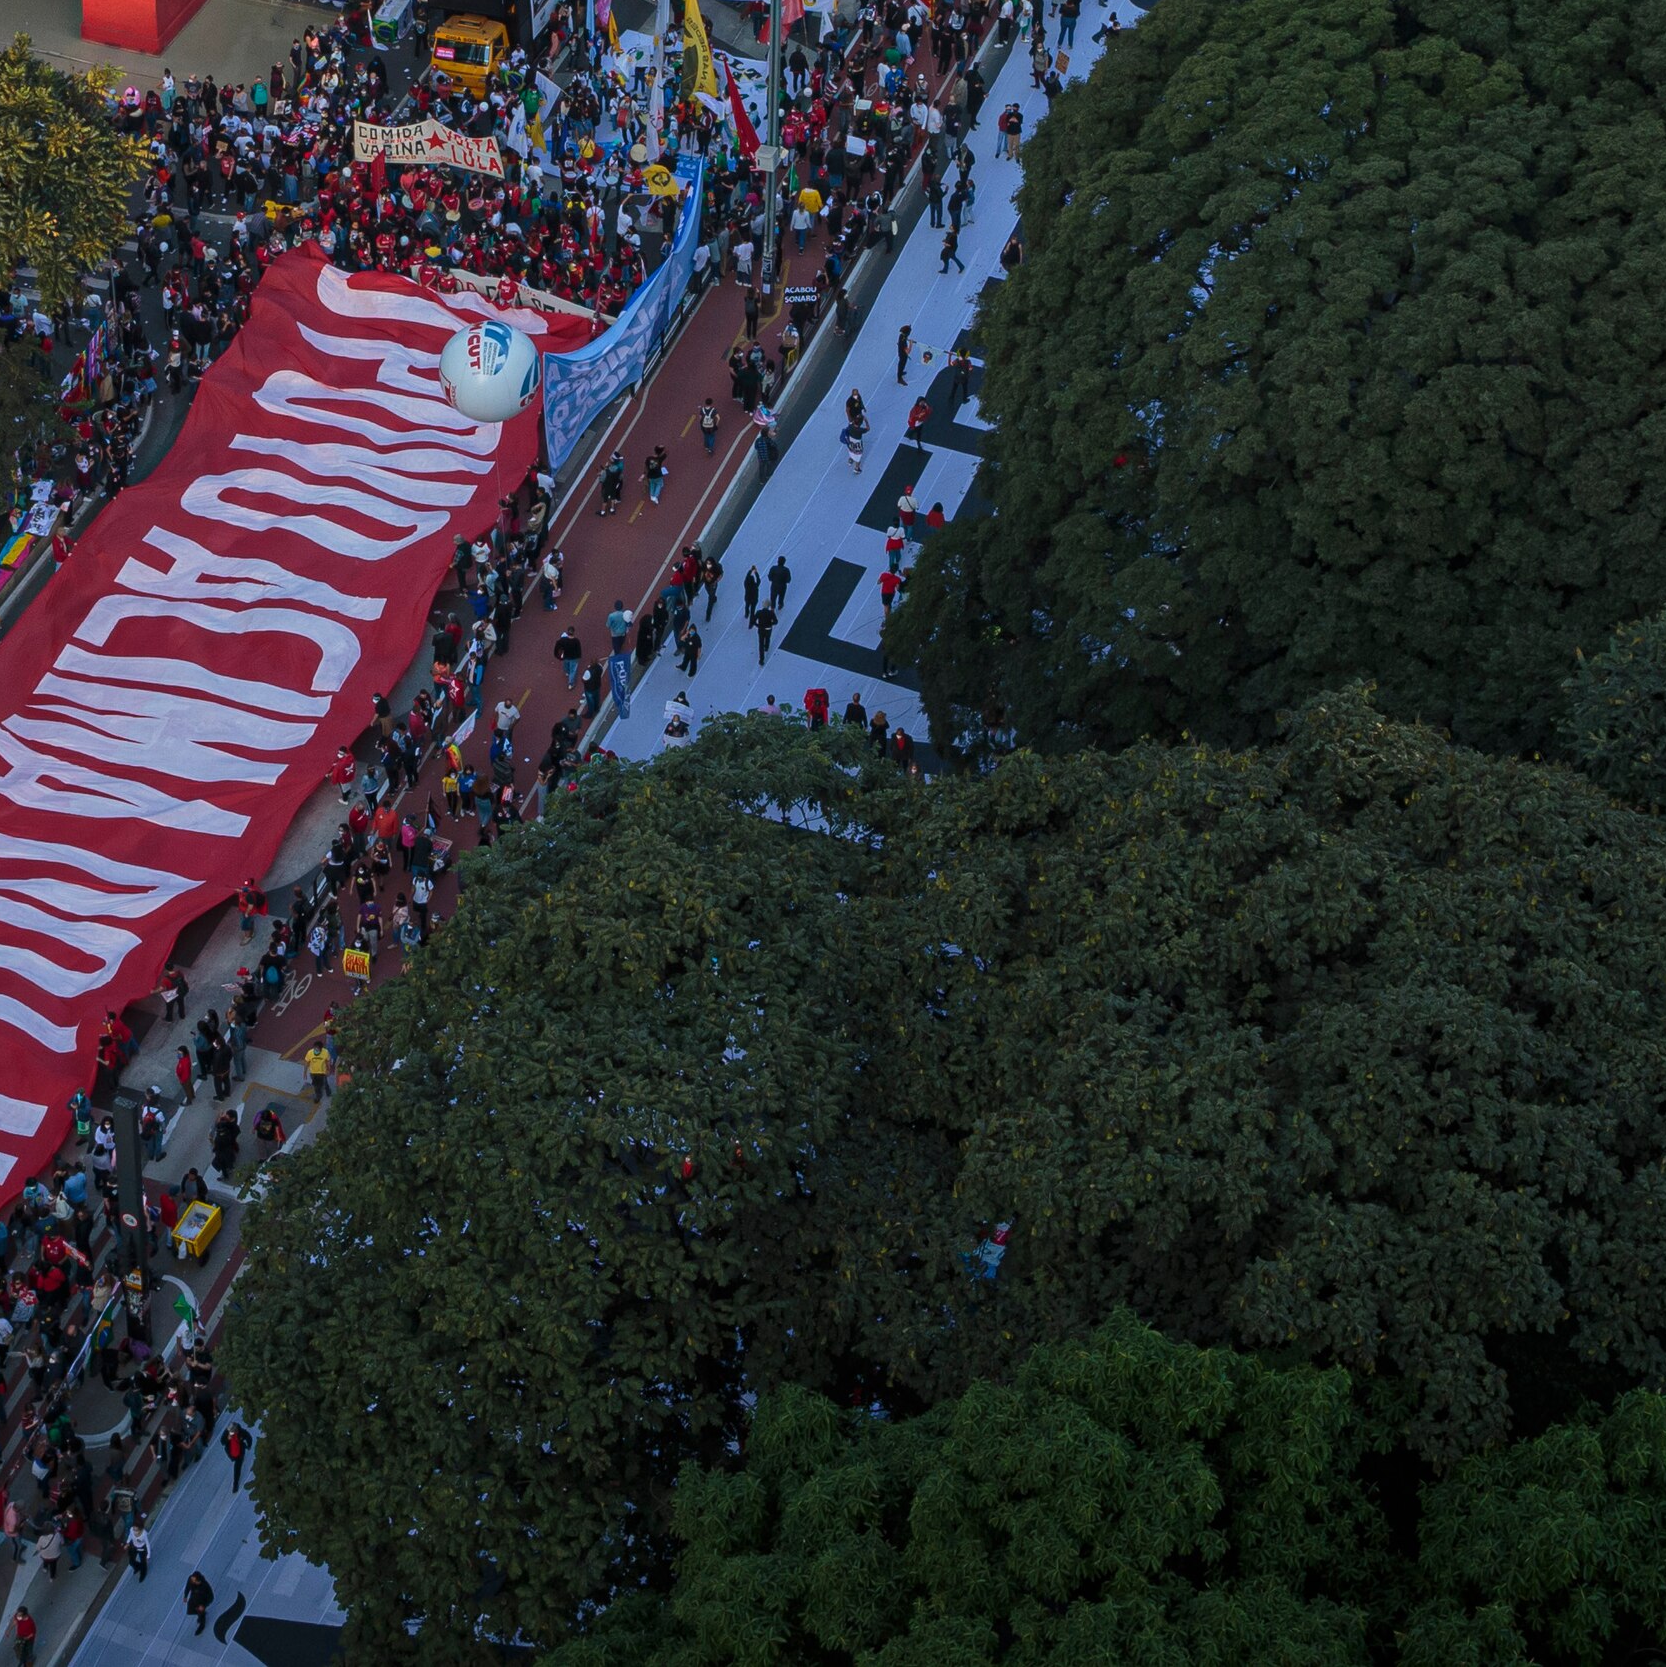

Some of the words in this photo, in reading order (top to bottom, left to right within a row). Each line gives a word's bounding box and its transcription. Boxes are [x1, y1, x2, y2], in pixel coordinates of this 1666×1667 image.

[359, 125, 424, 140] COMIDA
[442, 126, 497, 153] VOLTA
[360, 140, 426, 156] VACINA
[451, 144, 502, 175] LULA
[180, 320, 503, 561] POVO
